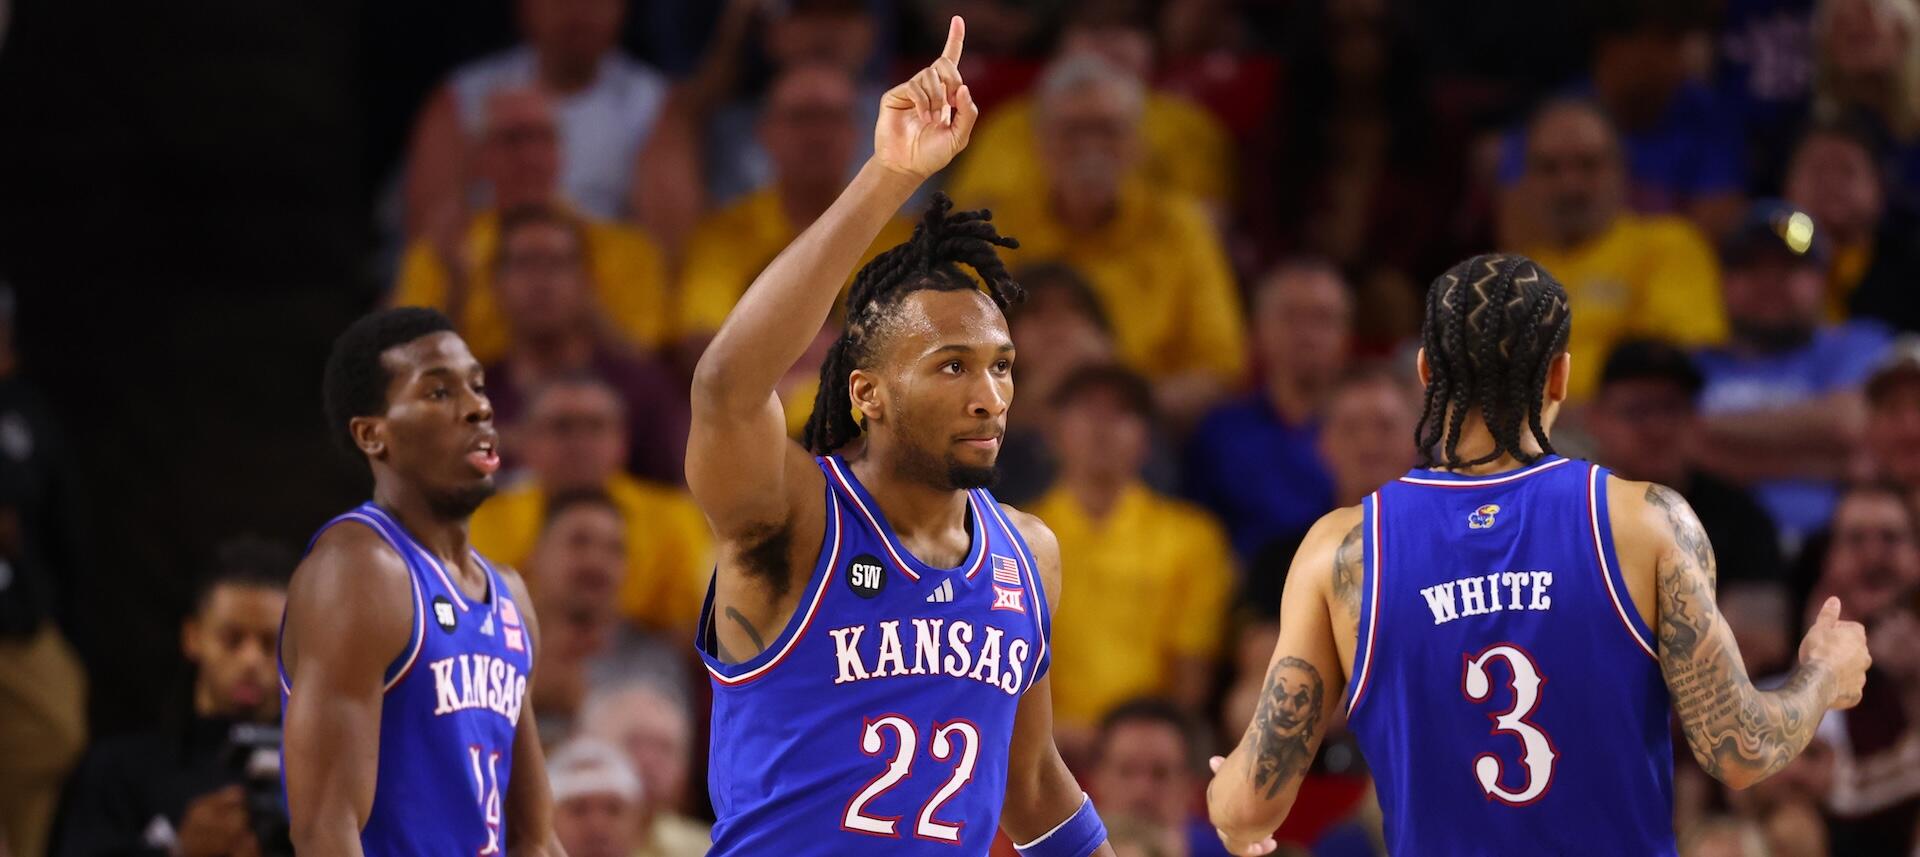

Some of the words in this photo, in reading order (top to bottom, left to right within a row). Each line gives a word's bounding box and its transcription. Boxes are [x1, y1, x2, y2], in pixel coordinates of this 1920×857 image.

[851, 563, 882, 590] SW
[992, 584, 1026, 613] XII
[1420, 571, 1553, 625] WHITE
[429, 653, 526, 728] KANSAS
[829, 618, 1029, 696] KANSAS
[1461, 642, 1560, 807] 3
[469, 744, 501, 856] 14
[841, 713, 980, 844] 22
